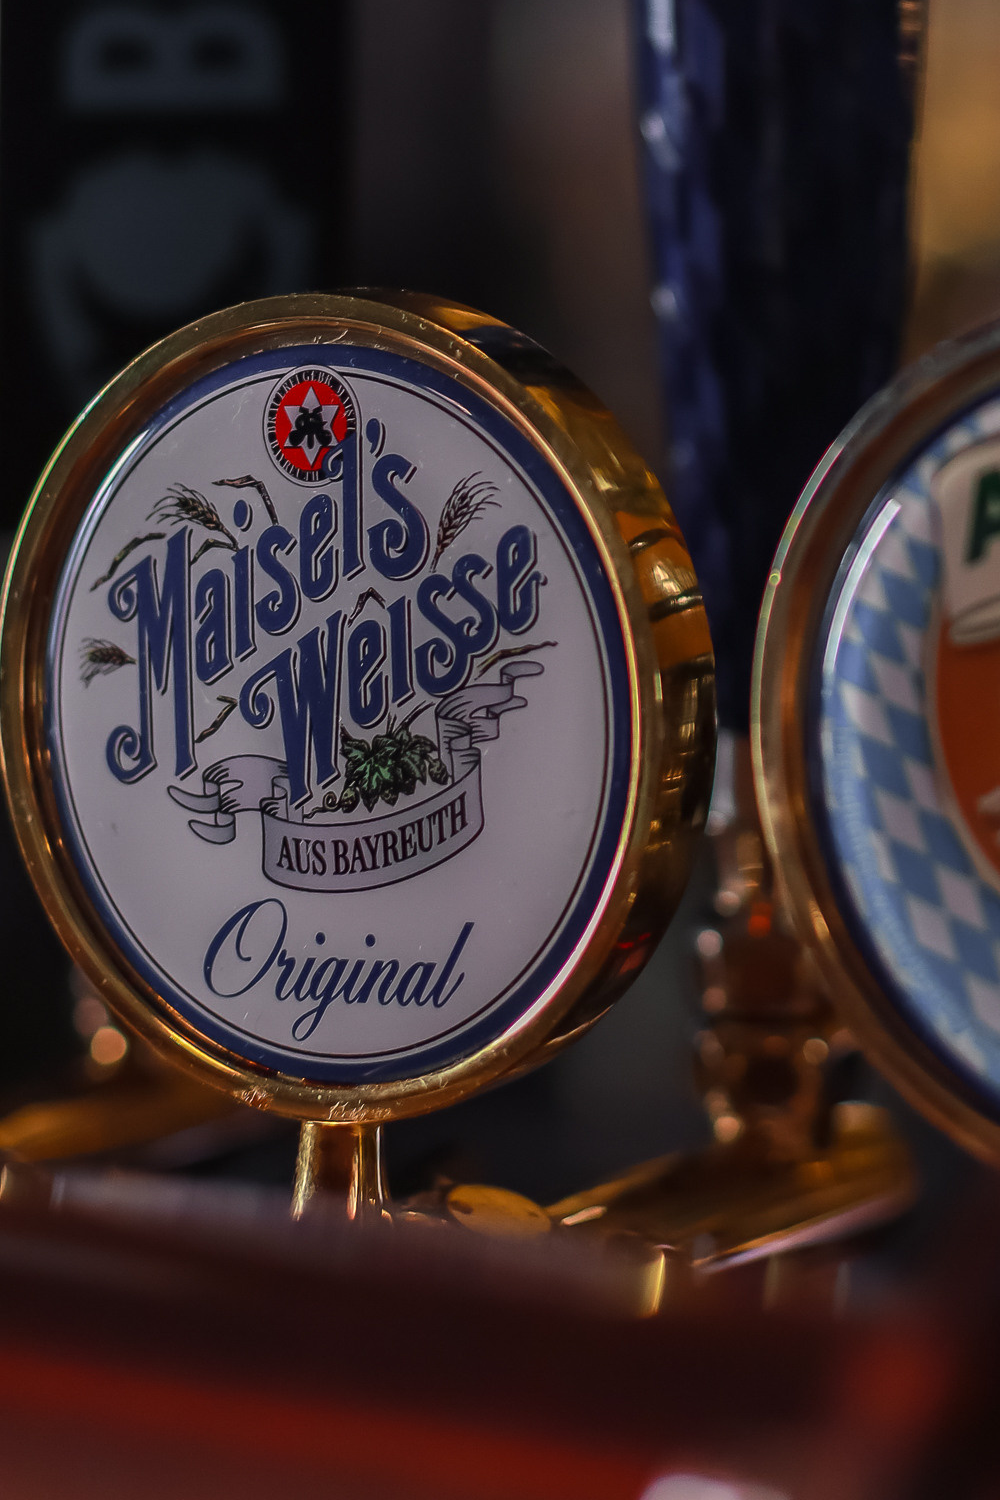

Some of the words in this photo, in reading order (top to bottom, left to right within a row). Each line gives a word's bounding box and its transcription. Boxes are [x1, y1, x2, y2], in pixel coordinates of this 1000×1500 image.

[106, 418, 428, 784] Maisel's
[240, 525, 547, 808] Weisse
[276, 836, 327, 875] AUS
[333, 791, 468, 875] BAYREUTH
[203, 898, 475, 1041] Original
